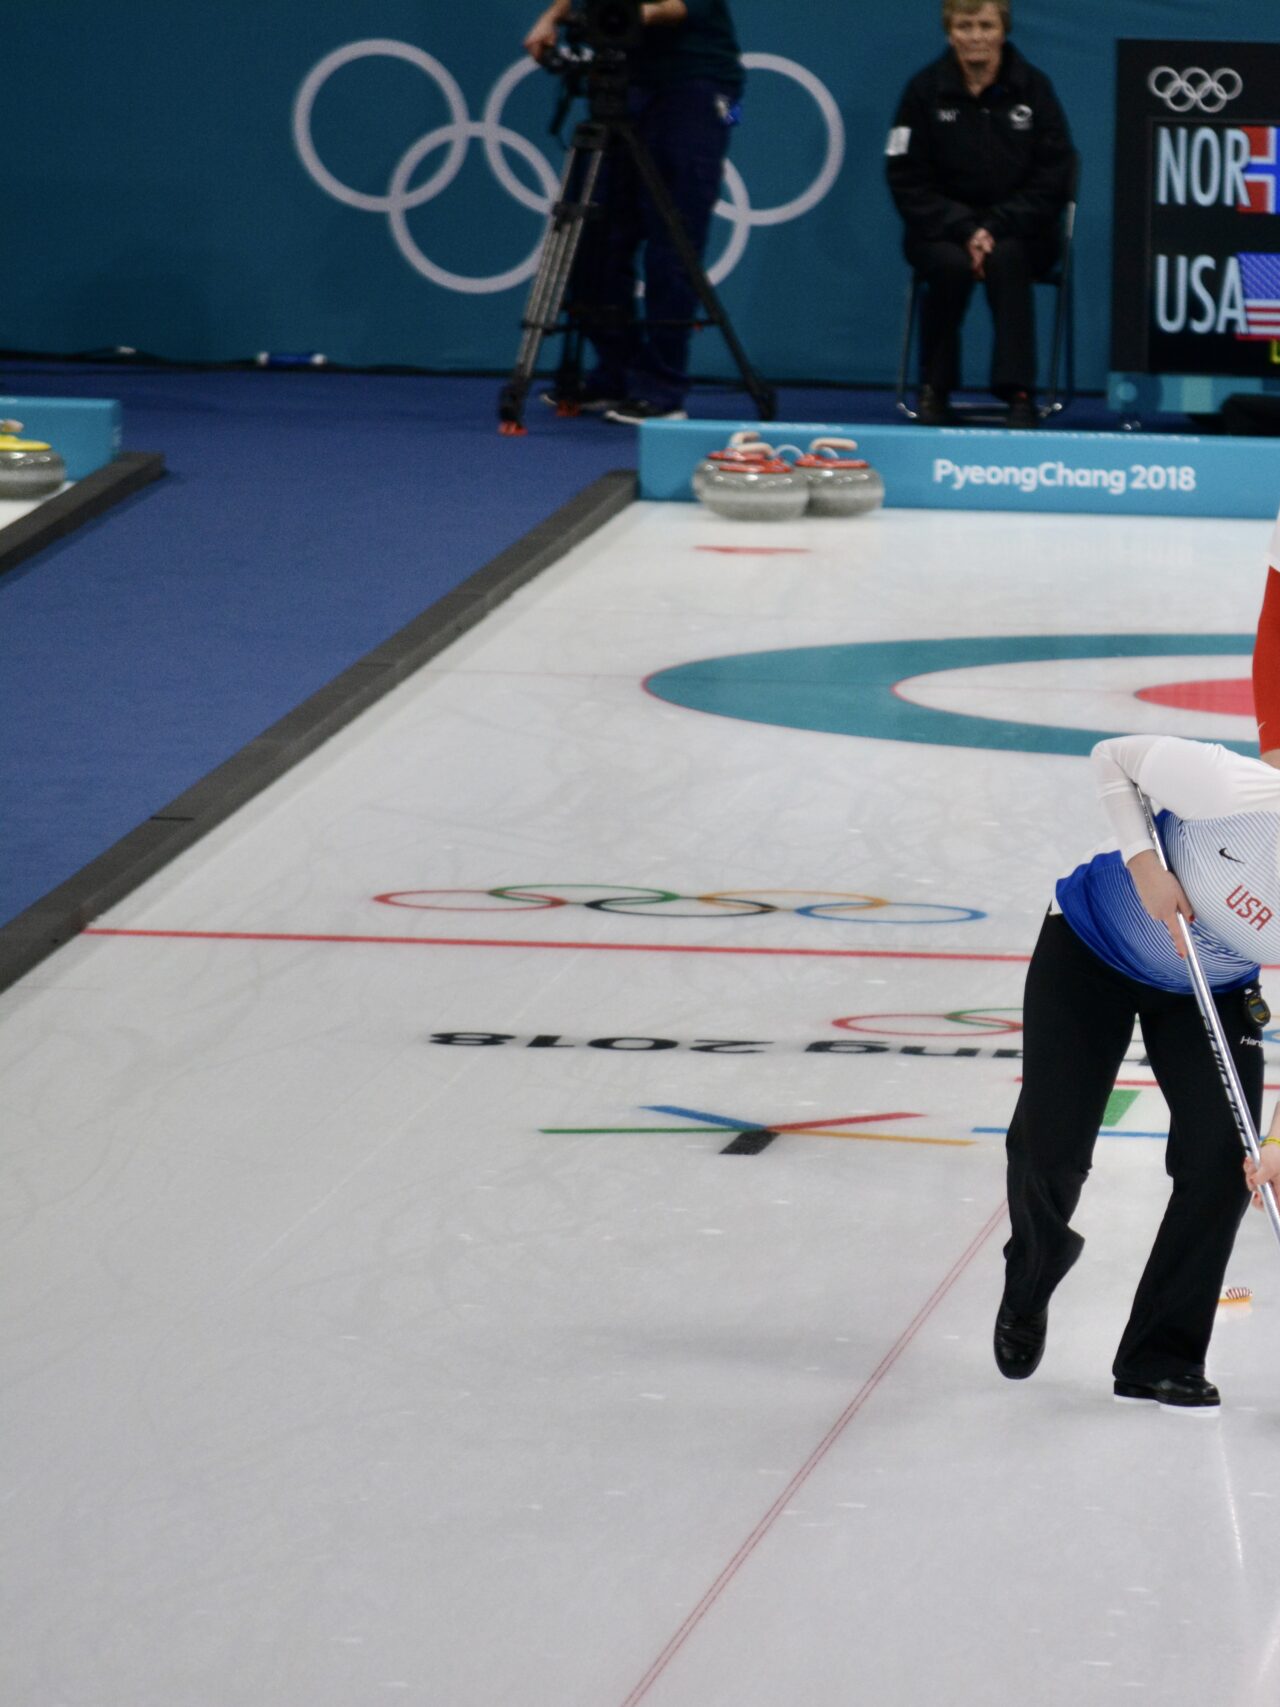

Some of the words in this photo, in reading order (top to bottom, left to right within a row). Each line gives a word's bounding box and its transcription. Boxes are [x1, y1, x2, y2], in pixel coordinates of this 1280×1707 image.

[1157, 126, 1252, 207] NOR
[1155, 254, 1249, 335] USA
[933, 458, 1127, 495] PyeongChang
[1130, 464, 1196, 491] 2018
[1225, 883, 1274, 932] USA
[429, 1031, 774, 1055] 2018
